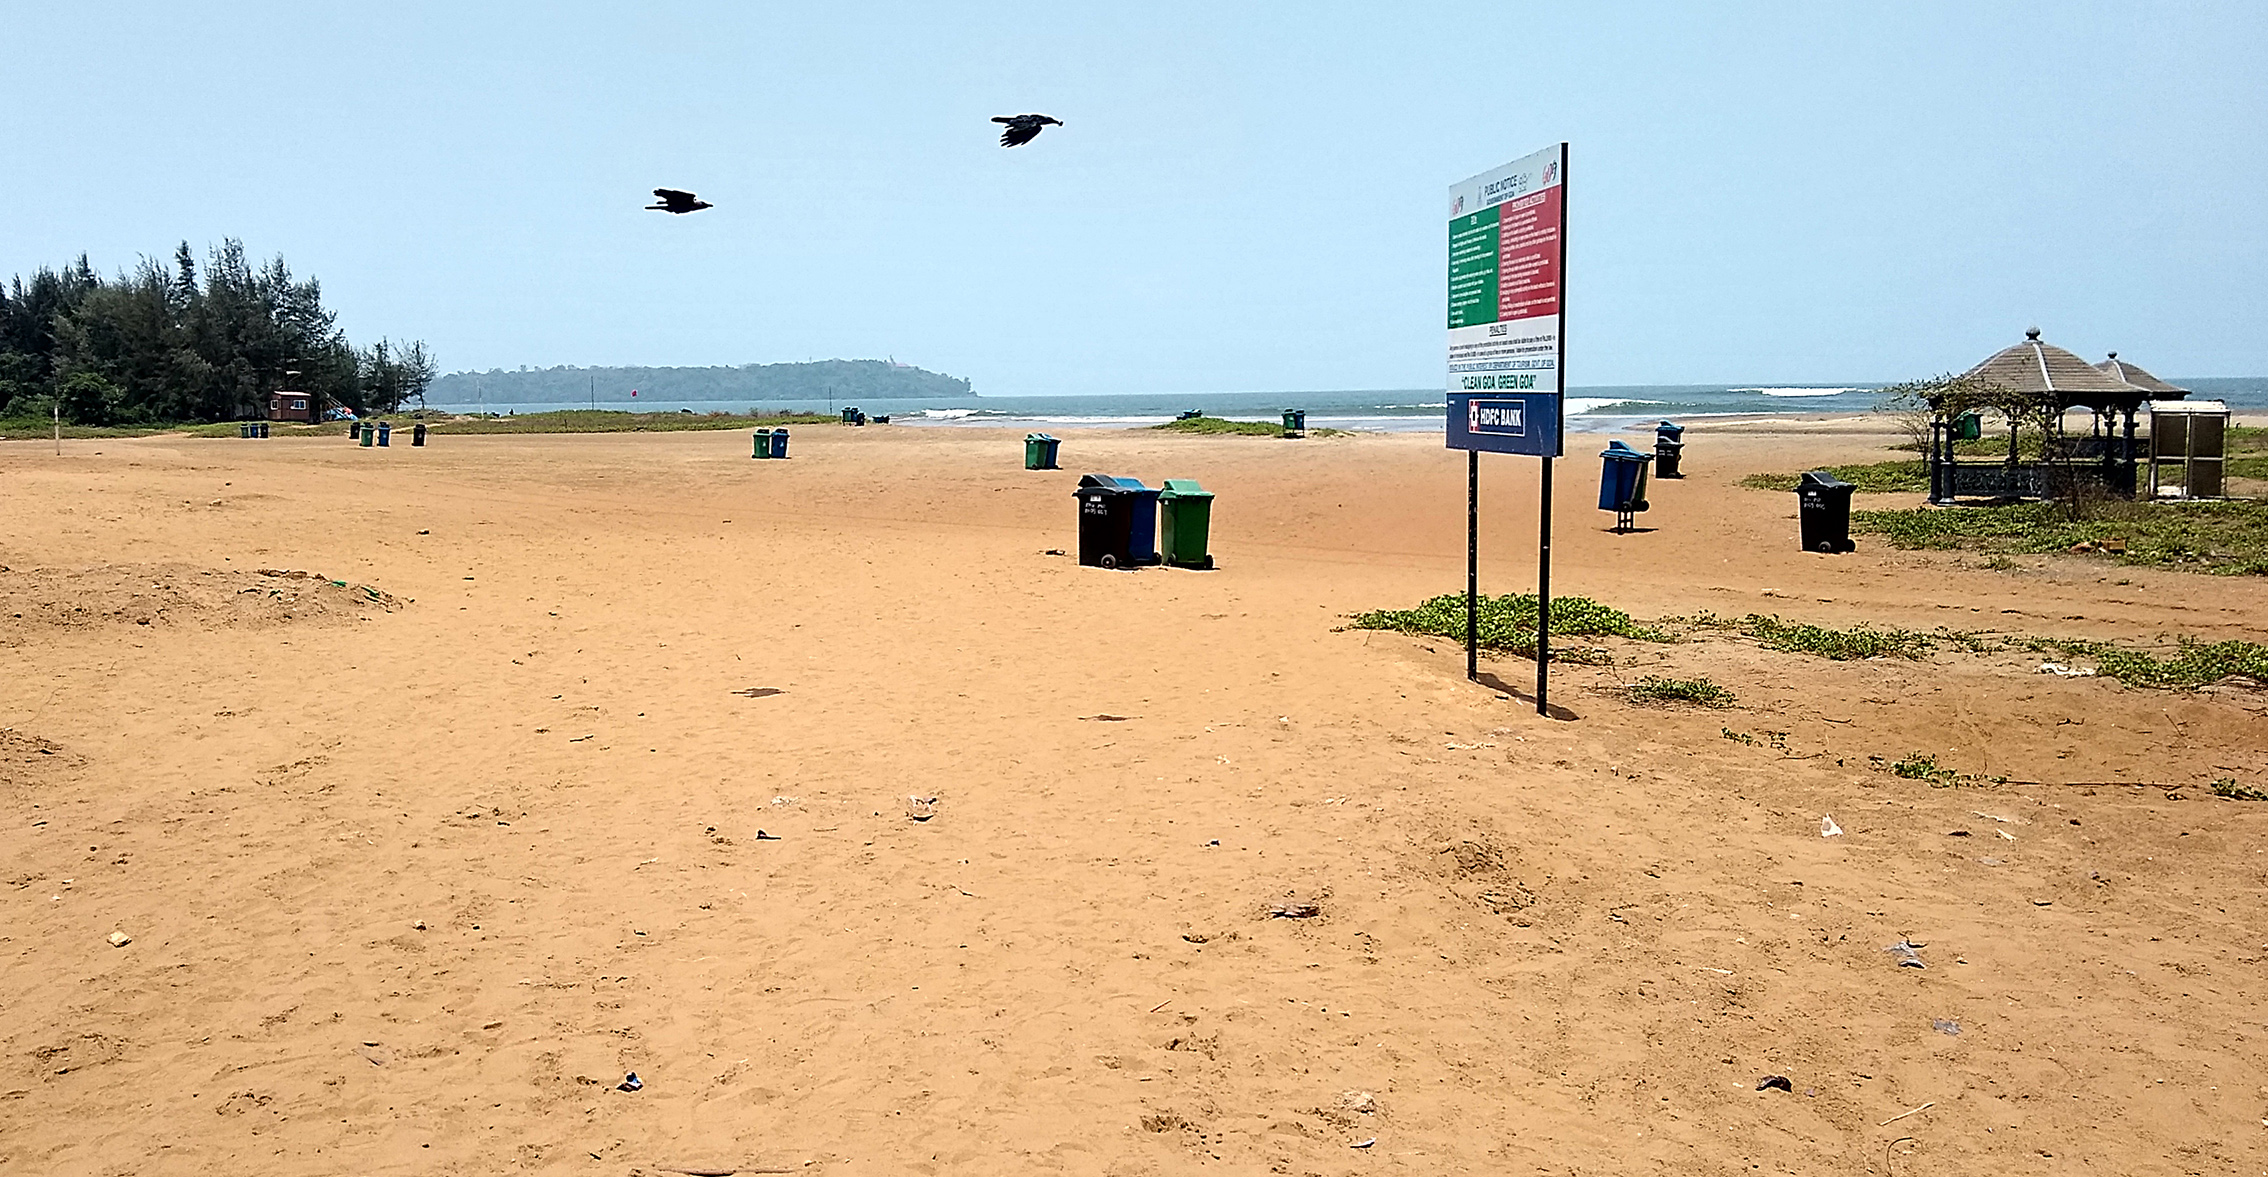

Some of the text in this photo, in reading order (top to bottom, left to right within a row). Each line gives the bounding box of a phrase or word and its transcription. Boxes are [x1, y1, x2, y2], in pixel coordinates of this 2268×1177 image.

[1484, 174, 1517, 196] PUBLIC NOTICE
[1482, 375, 1496, 390] GOA
[1497, 374, 1518, 390] GREEN
[1480, 408, 1522, 427] HDFC BANK
